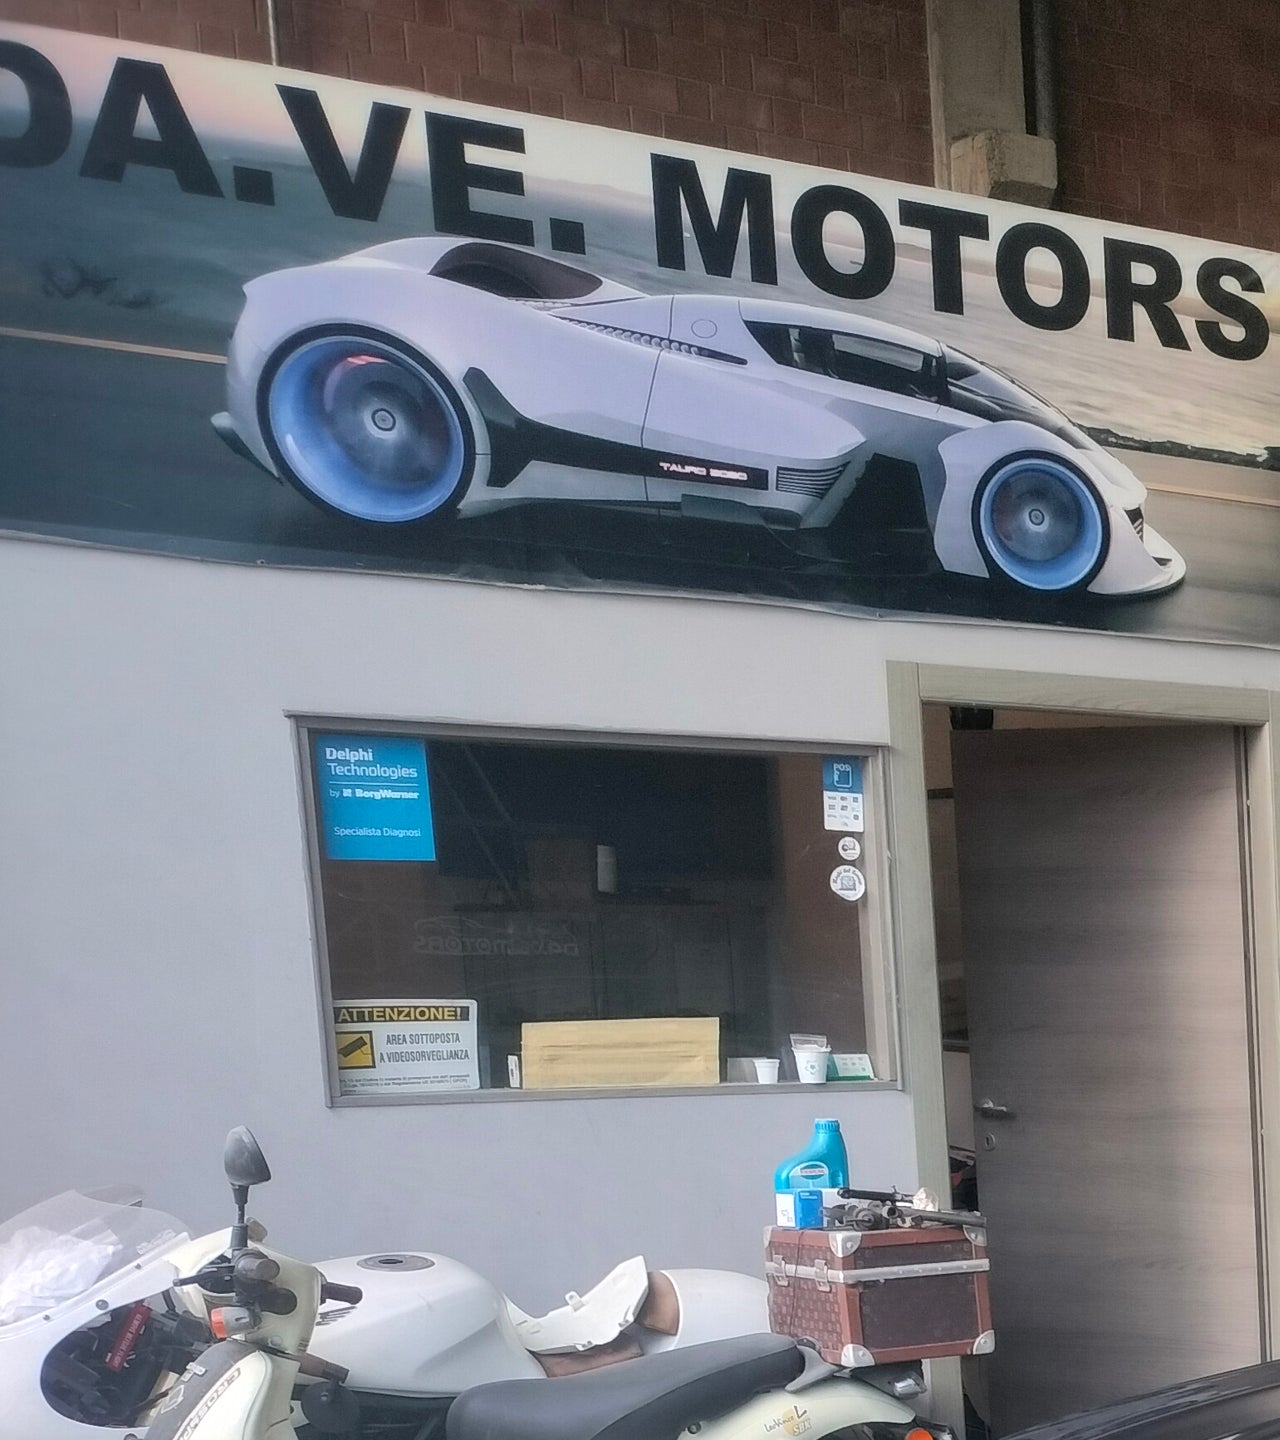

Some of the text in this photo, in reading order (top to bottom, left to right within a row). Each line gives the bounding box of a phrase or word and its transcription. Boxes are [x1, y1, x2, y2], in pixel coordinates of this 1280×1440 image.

[650, 152, 1271, 363] MOTORS
[325, 747, 374, 763] Delphi
[327, 762, 418, 779] Technologies
[329, 788, 420, 800] by BorgWarner
[334, 826, 422, 838] Specialista Diagnosi
[339, 1006, 462, 1022] ATTENZIONE!
[386, 1032, 461, 1046] AREA SOTTOPOSTA
[380, 1049, 470, 1064] A VIDEOSORVEGLIANZA
[792, 1417, 813, 1437] SBK
